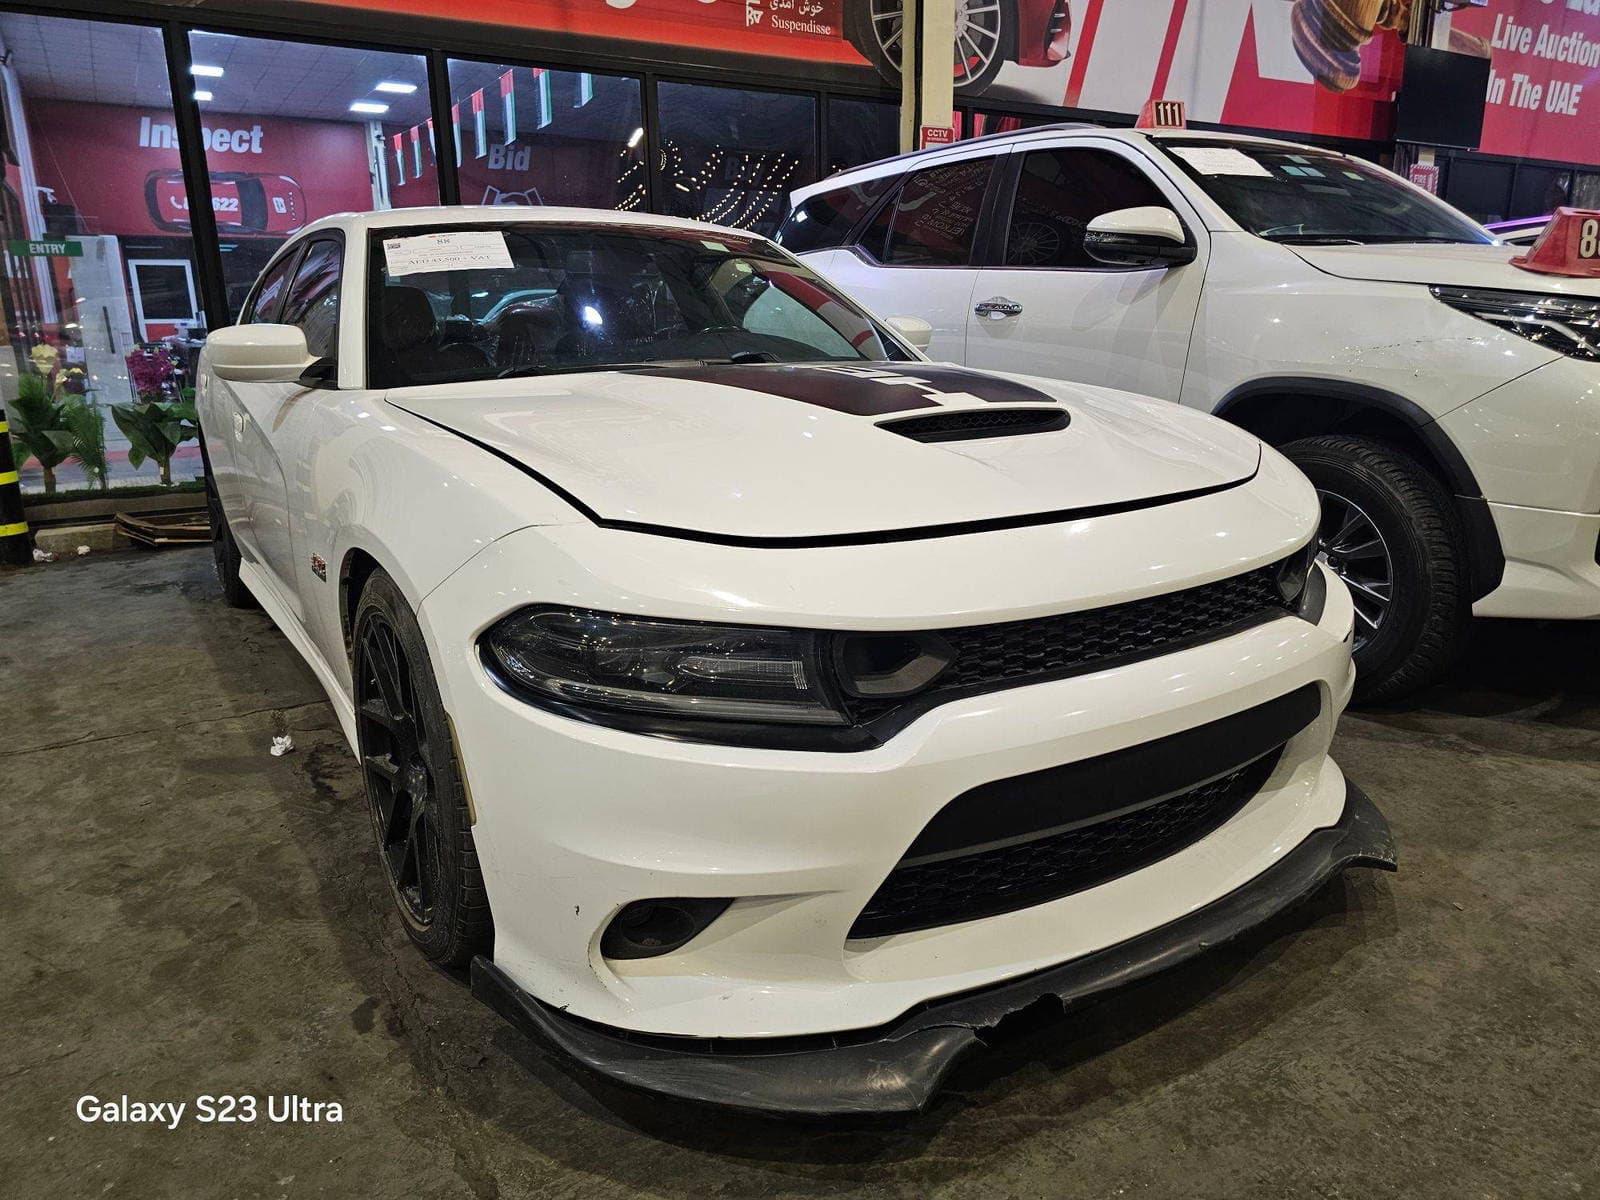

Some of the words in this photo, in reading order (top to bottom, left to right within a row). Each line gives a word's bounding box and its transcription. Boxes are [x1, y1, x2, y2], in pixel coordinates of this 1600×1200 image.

[771, 14, 832, 35] Suspendisse
[1491, 13, 1533, 54] Live
[1532, 23, 1600, 69] Auction
[1485, 68, 1506, 105] In
[1508, 73, 1543, 110] The
[1545, 79, 1584, 116] UAE
[1158, 102, 1181, 127] 111
[927, 129, 949, 138] CCTV
[488, 143, 531, 171] Bid
[28, 243, 66, 254] ENTRY
